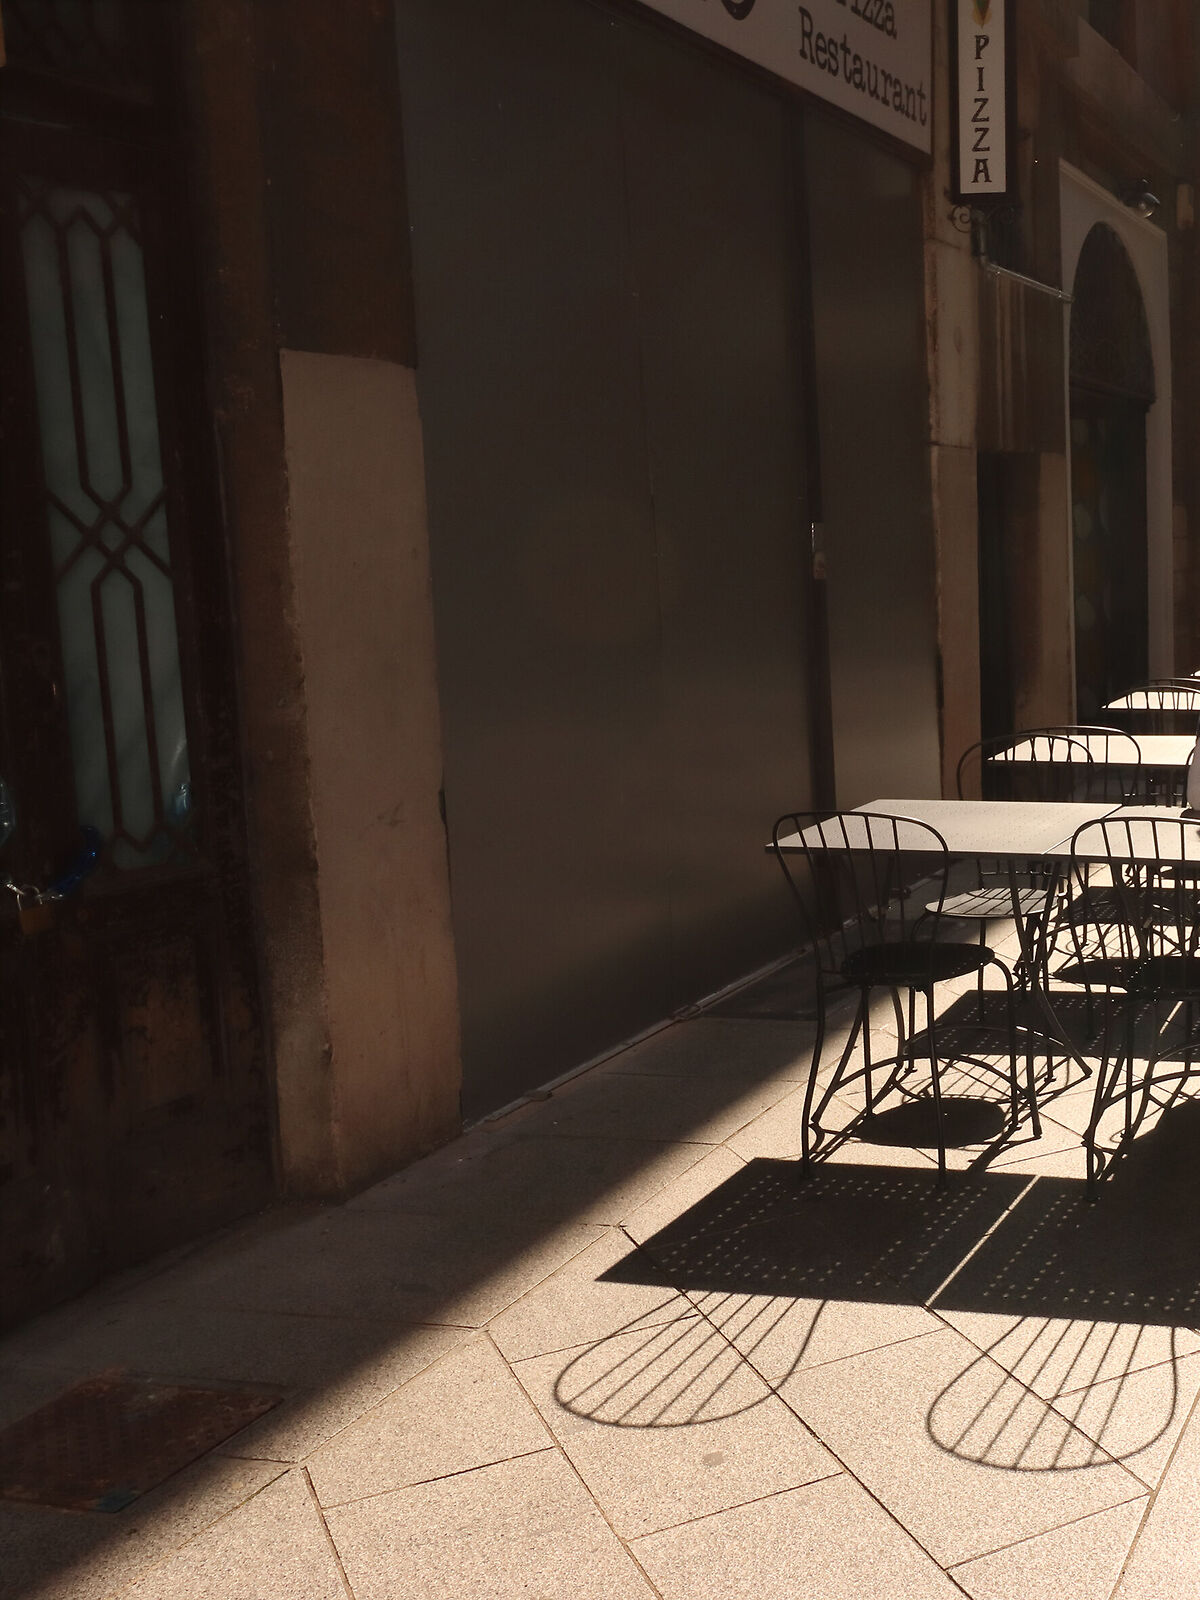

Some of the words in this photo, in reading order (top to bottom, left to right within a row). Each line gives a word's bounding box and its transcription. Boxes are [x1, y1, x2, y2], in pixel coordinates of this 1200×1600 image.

[799, 6, 927, 126] Restaurant
[836, 0, 897, 40] zza
[971, 35, 992, 183] PIZZA
